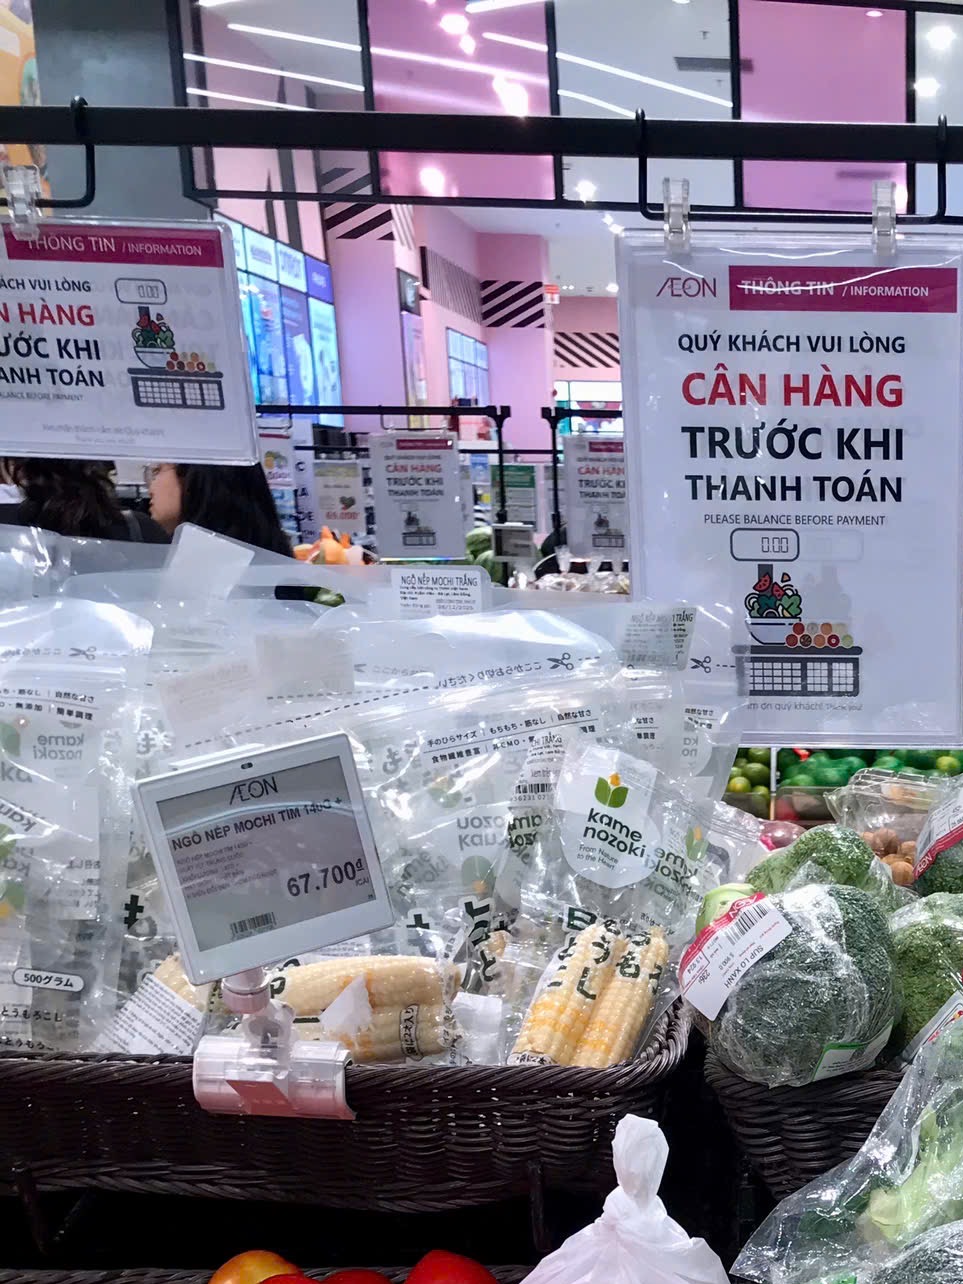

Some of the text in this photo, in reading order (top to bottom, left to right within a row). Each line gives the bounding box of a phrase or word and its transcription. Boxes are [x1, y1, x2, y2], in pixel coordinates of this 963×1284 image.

[88, 236, 116, 252] TIN
[28, 280, 51, 291] VUI
[55, 277, 92, 292] LÒNG
[806, 281, 835, 296] TIN
[850, 286, 929, 298] INFORMATION
[18, 298, 95, 327] HÀNG
[57, 338, 101, 361] KHI
[677, 330, 906, 354] QUÝ KHÁCH VUI LÒNG
[47, 366, 105, 388] TOÁN
[681, 363, 904, 408] CÂN HÀNG
[681, 418, 904, 461] TRƯỚC KHI
[685, 469, 902, 503] THANH TOÁN
[704, 514, 886, 526] PLEASE BALANCE BEFORE PAYMENT
[229, 776, 279, 805] ÆON
[172, 830, 202, 851] NGÔ
[205, 823, 231, 842] NẾP
[234, 813, 277, 835] MOCHI
[587, 808, 643, 842] kame
[583, 825, 647, 858] nozoki
[287, 857, 364, 897] 67.700đ
[23, 973, 74, 988] 500グラム
[720, 967, 746, 989] XANH
[1, 1005, 63, 1023] とうもろこし
